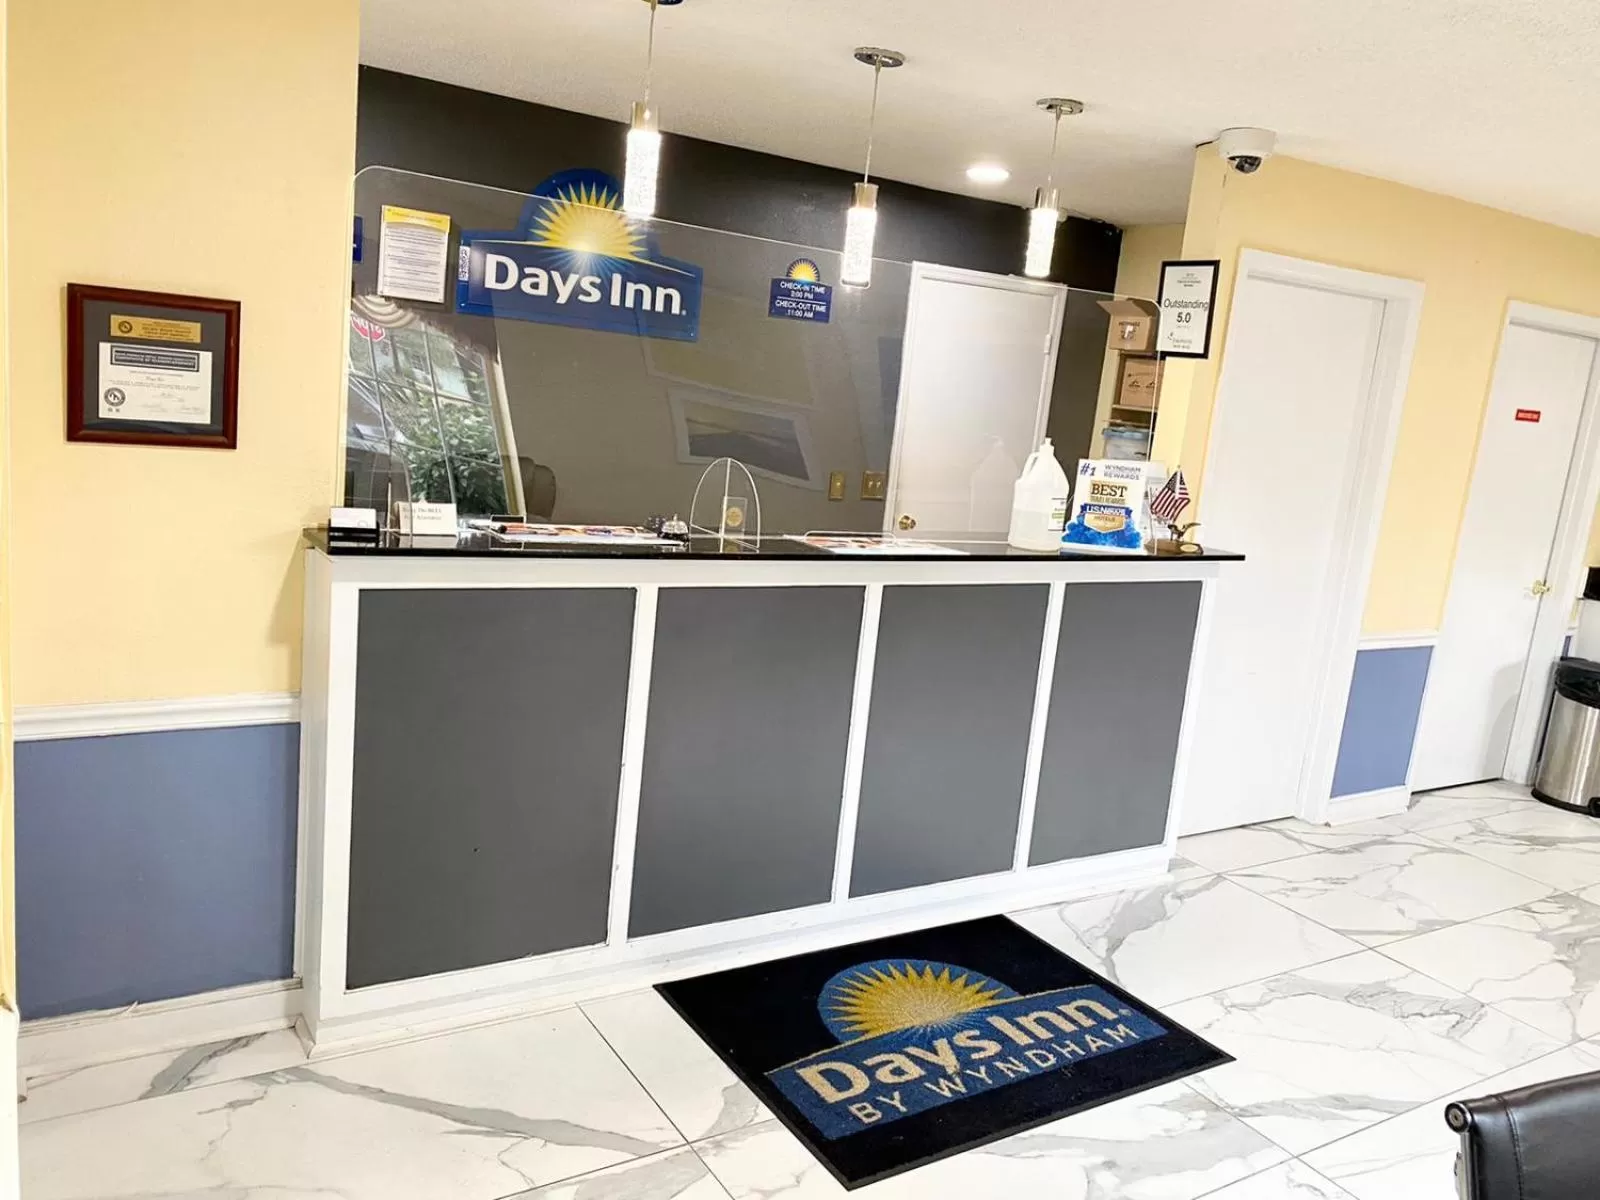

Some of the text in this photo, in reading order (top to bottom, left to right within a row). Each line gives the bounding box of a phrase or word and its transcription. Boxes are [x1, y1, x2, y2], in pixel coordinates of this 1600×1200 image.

[484, 253, 681, 315] Days Inn
[780, 281, 826, 294] CHECK-IN TIME
[775, 300, 826, 312] CHECK-OUT TIME
[1163, 298, 1209, 312] Outstanding
[1176, 311, 1192, 323] 5.0
[1080, 462, 1097, 476] #1
[1105, 464, 1141, 472] WYNDHAM
[1104, 472, 1139, 480] REWARDS
[1091, 483, 1127, 498] BEST
[797, 998, 1119, 1103] Days Inn
[848, 1023, 1141, 1125] BY WYNDHAM
